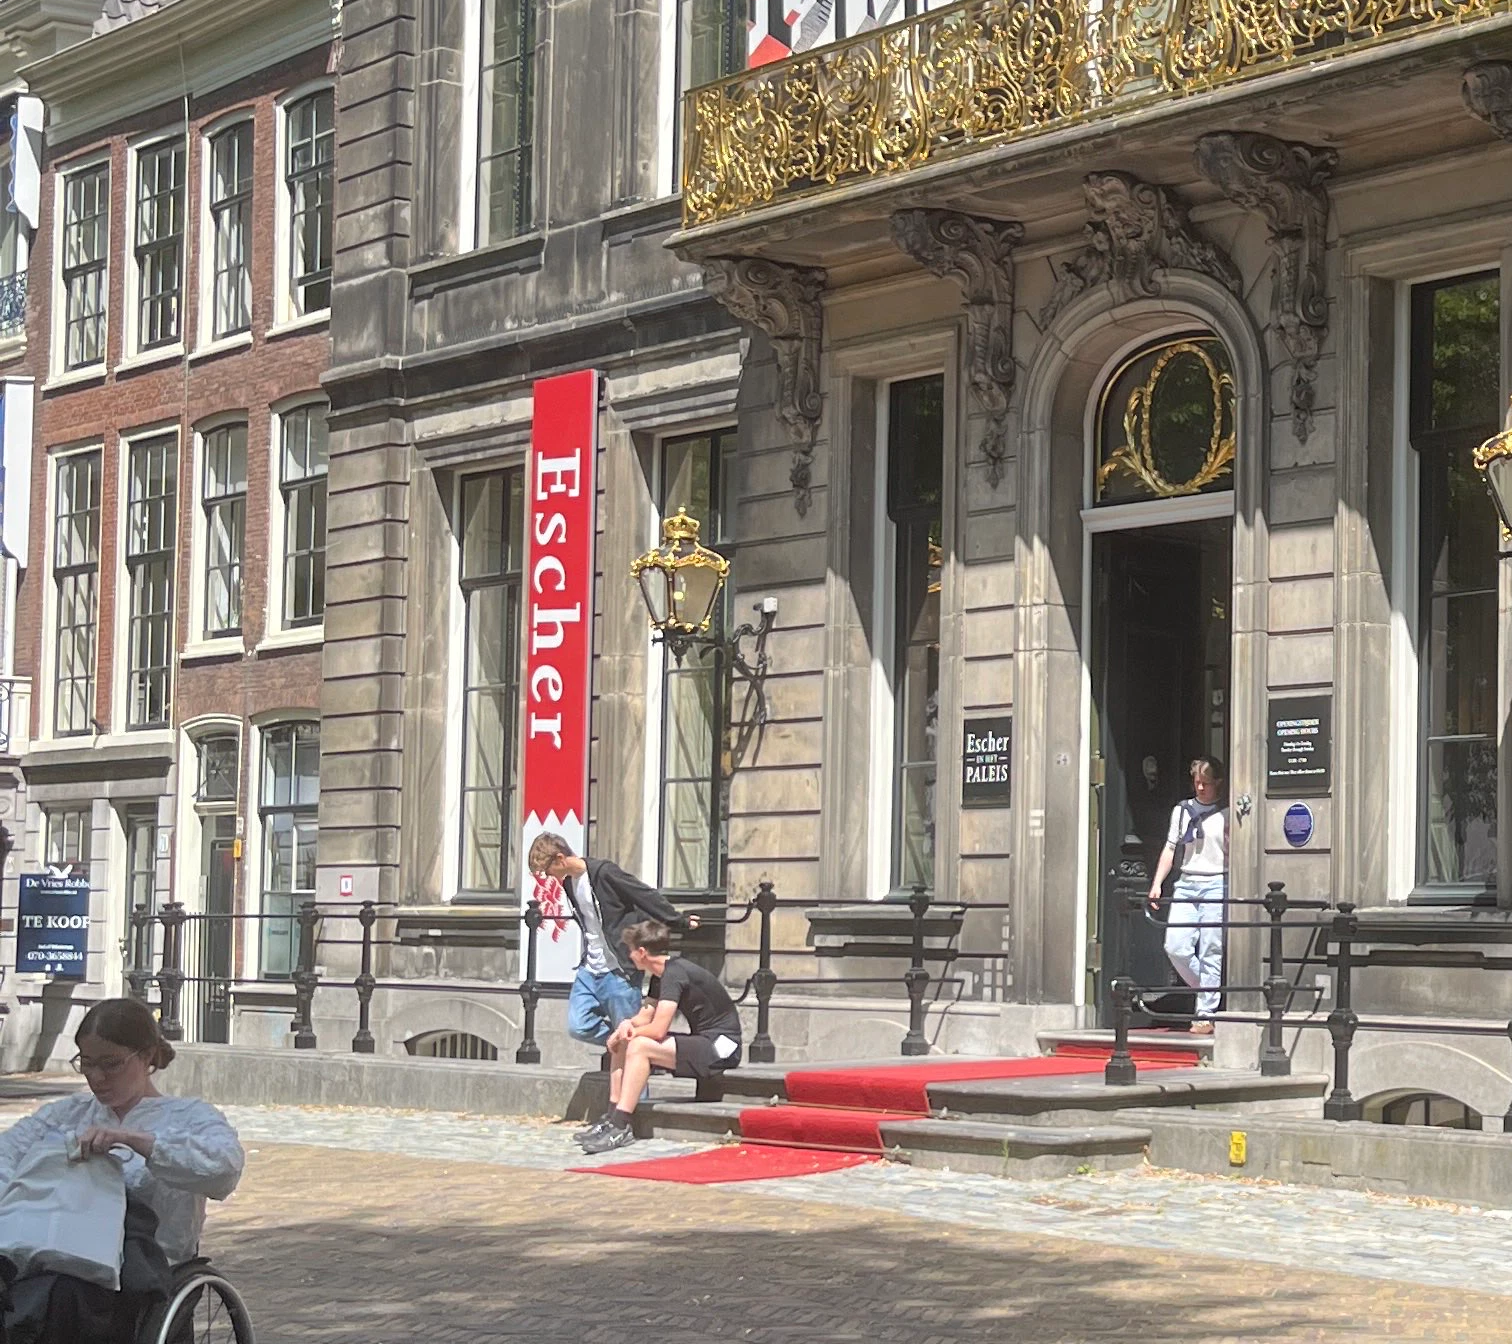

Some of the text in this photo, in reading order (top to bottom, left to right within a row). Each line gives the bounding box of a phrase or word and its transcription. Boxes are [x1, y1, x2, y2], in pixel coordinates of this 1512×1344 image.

[530, 447, 581, 750] Escher
[966, 731, 1010, 753] Escher
[966, 764, 1008, 783] PALEIS
[26, 878, 40, 888] De
[22, 916, 43, 928] TE
